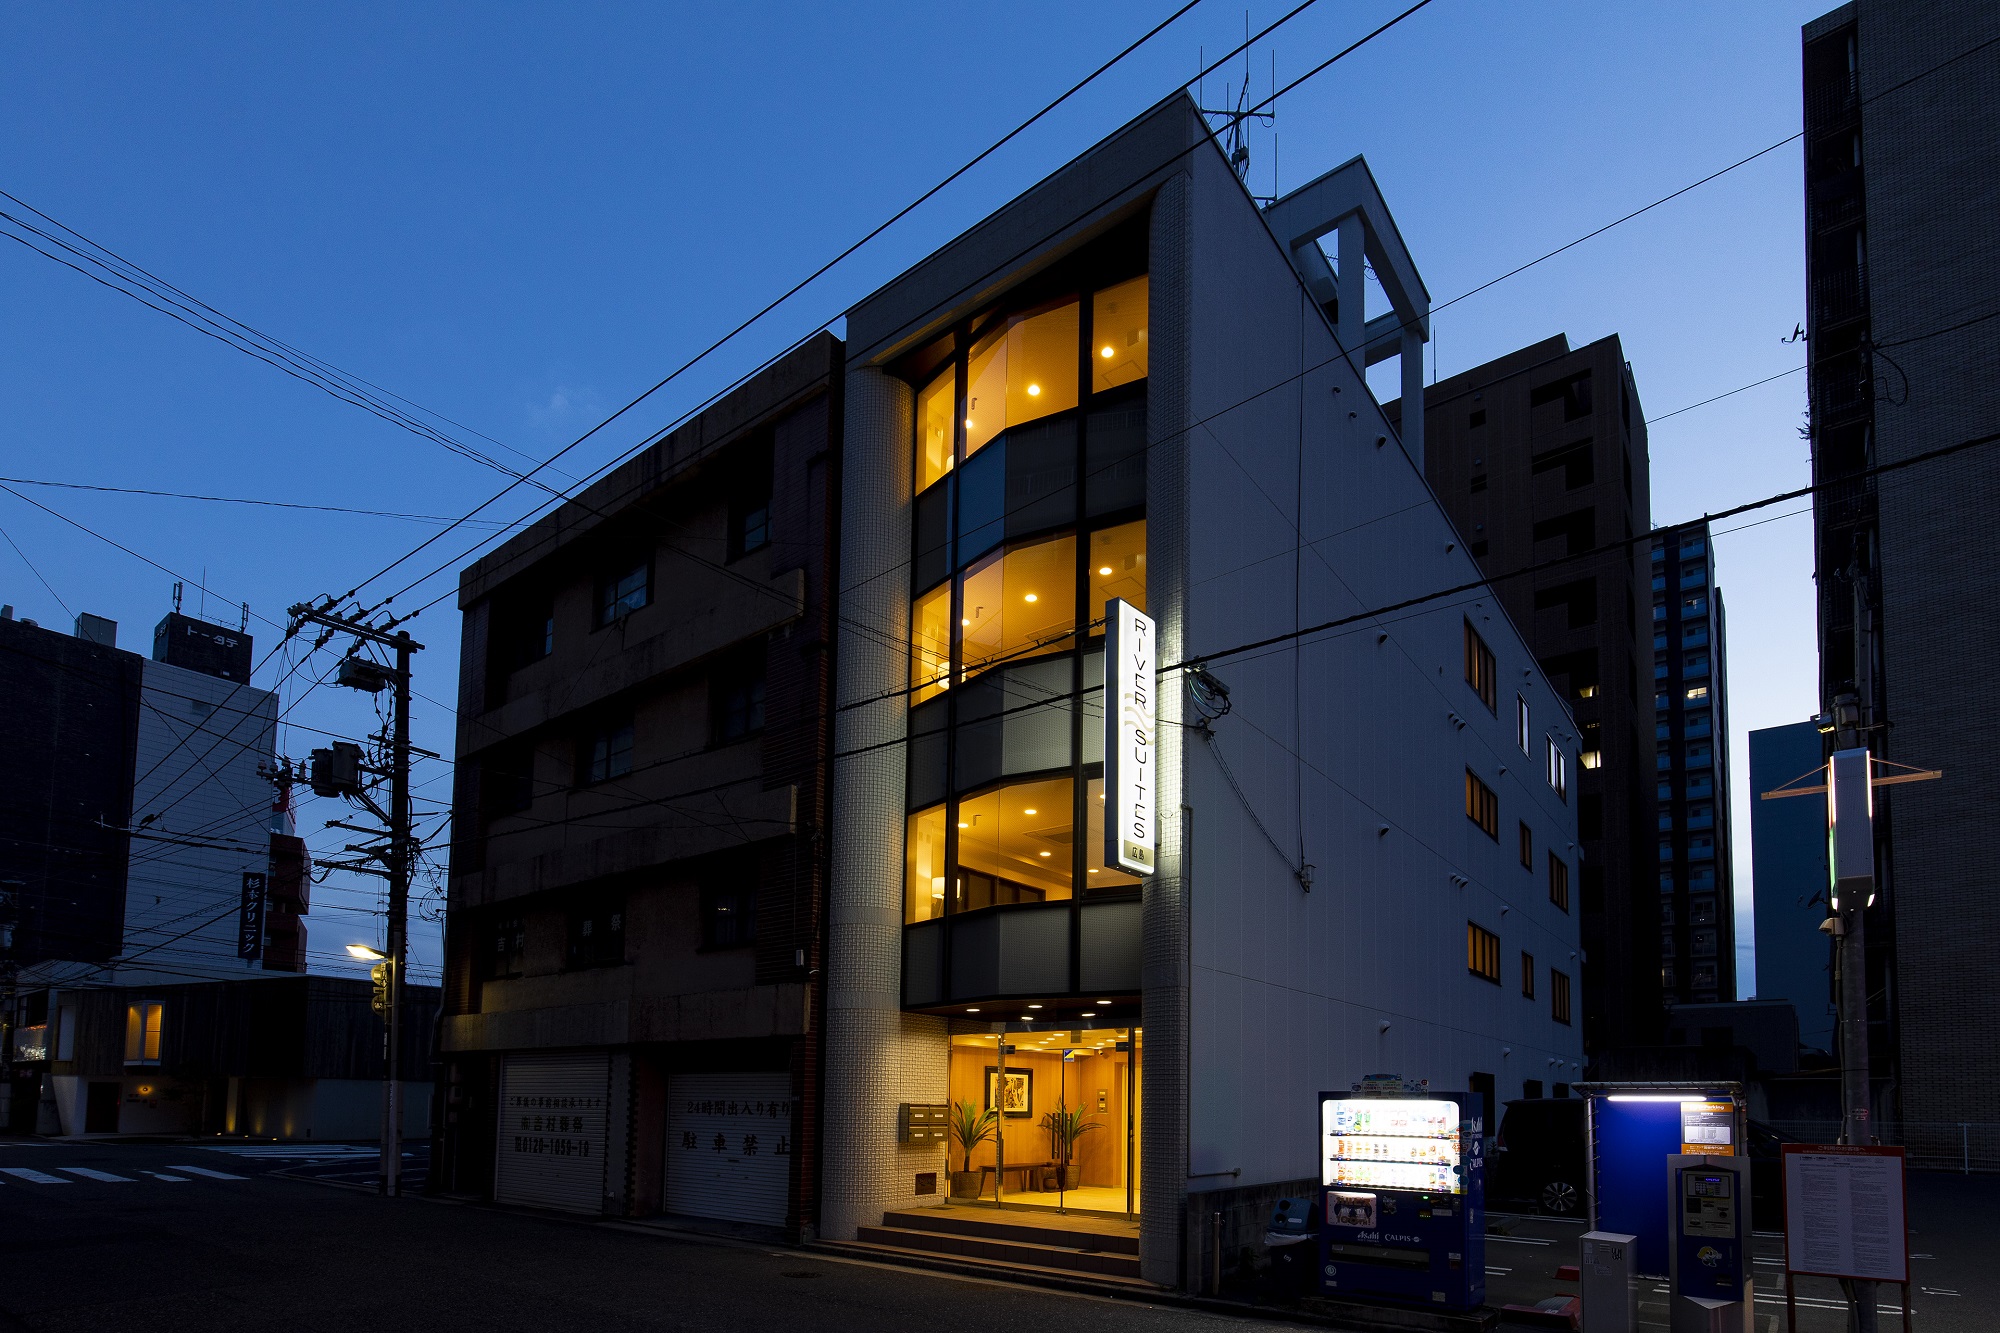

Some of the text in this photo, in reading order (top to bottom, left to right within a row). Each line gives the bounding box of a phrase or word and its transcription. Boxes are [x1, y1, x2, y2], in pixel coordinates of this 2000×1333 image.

[187, 625, 239, 648] トータテ
[1134, 618, 1146, 839] RIVER SUITES
[243, 878, 260, 954] 杉本クリニック
[687, 1100, 790, 1119] 24時間出入り有り
[1357, 1230, 1380, 1240] Asahi
[1384, 1233, 1411, 1242] CALPIS
